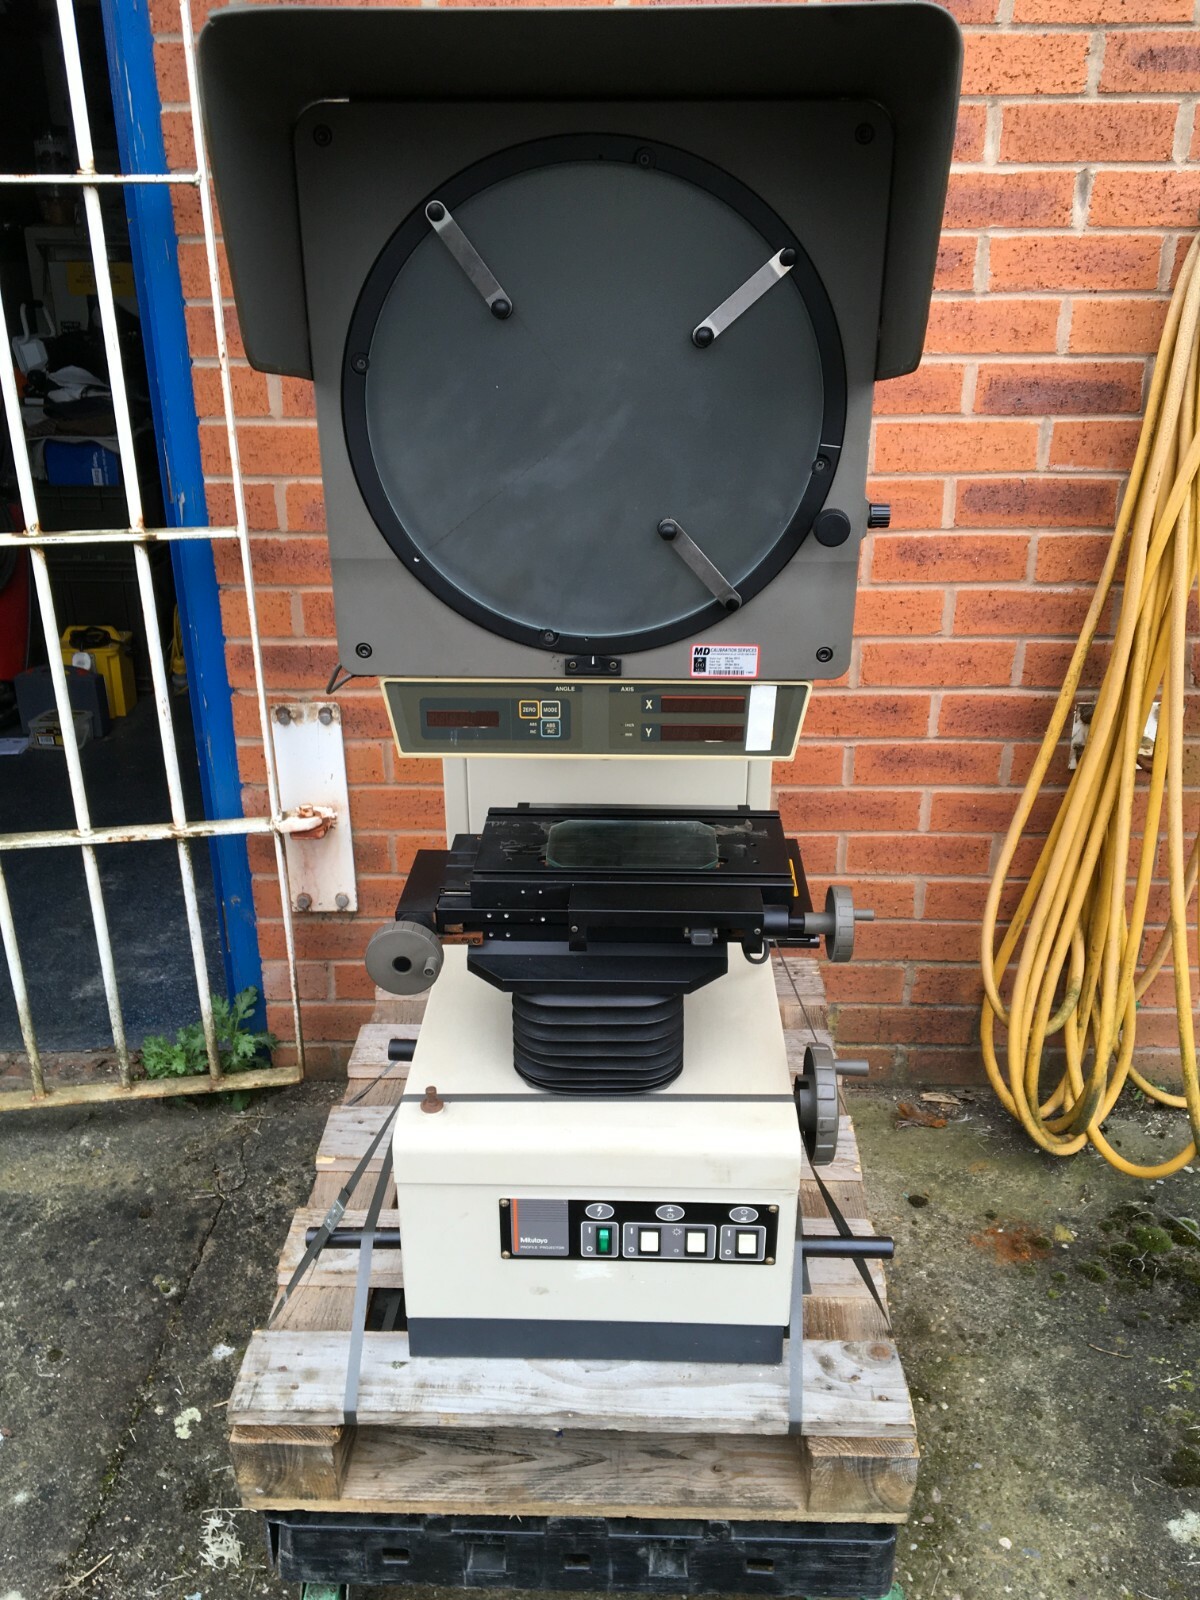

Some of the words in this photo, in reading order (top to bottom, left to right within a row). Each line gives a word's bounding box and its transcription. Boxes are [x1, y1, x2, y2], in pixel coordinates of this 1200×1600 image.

[694, 647, 710, 656] MD
[645, 699, 653, 710] X
[645, 727, 653, 738] Y
